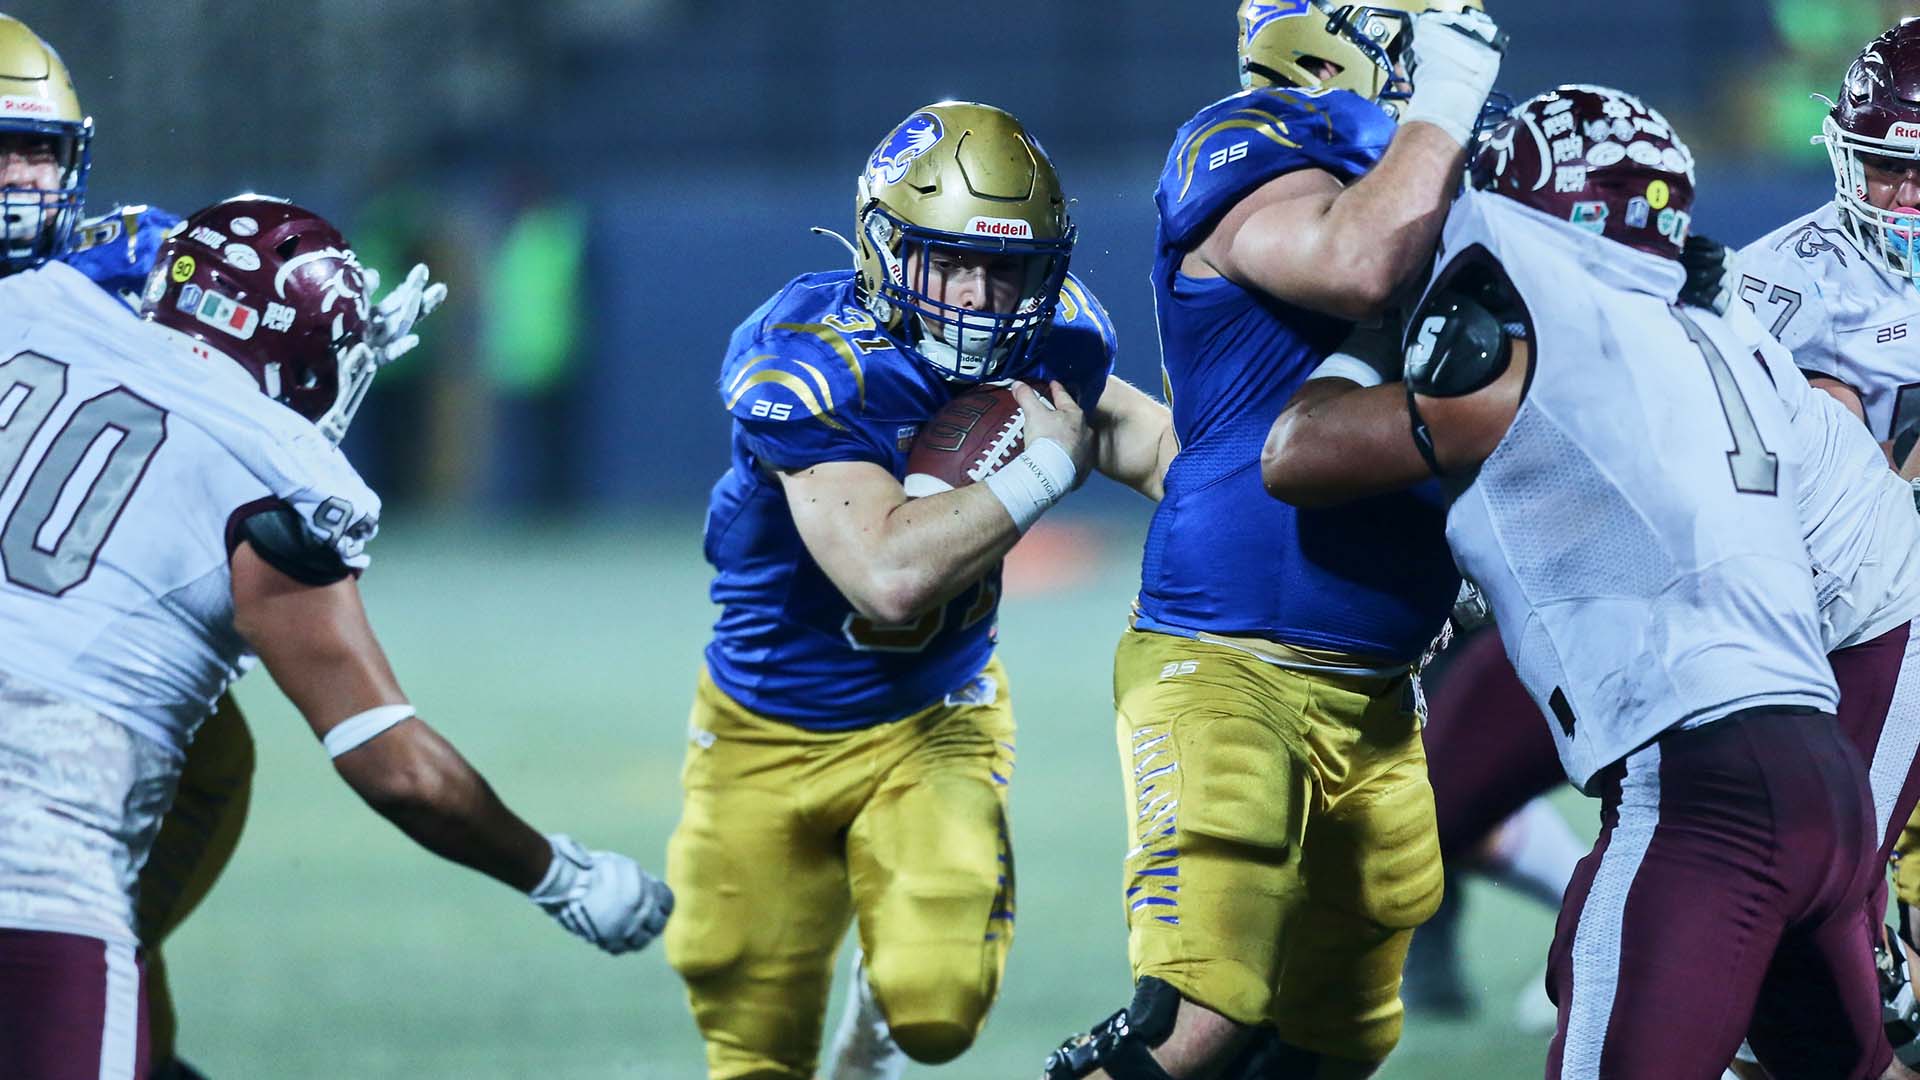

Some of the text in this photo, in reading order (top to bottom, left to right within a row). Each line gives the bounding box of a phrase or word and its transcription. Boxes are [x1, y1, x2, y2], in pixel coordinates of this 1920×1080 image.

[975, 221, 1027, 236] Riddell
[175, 261, 193, 278] 90
[821, 306, 896, 355] 31
[1668, 303, 1779, 497] 1
